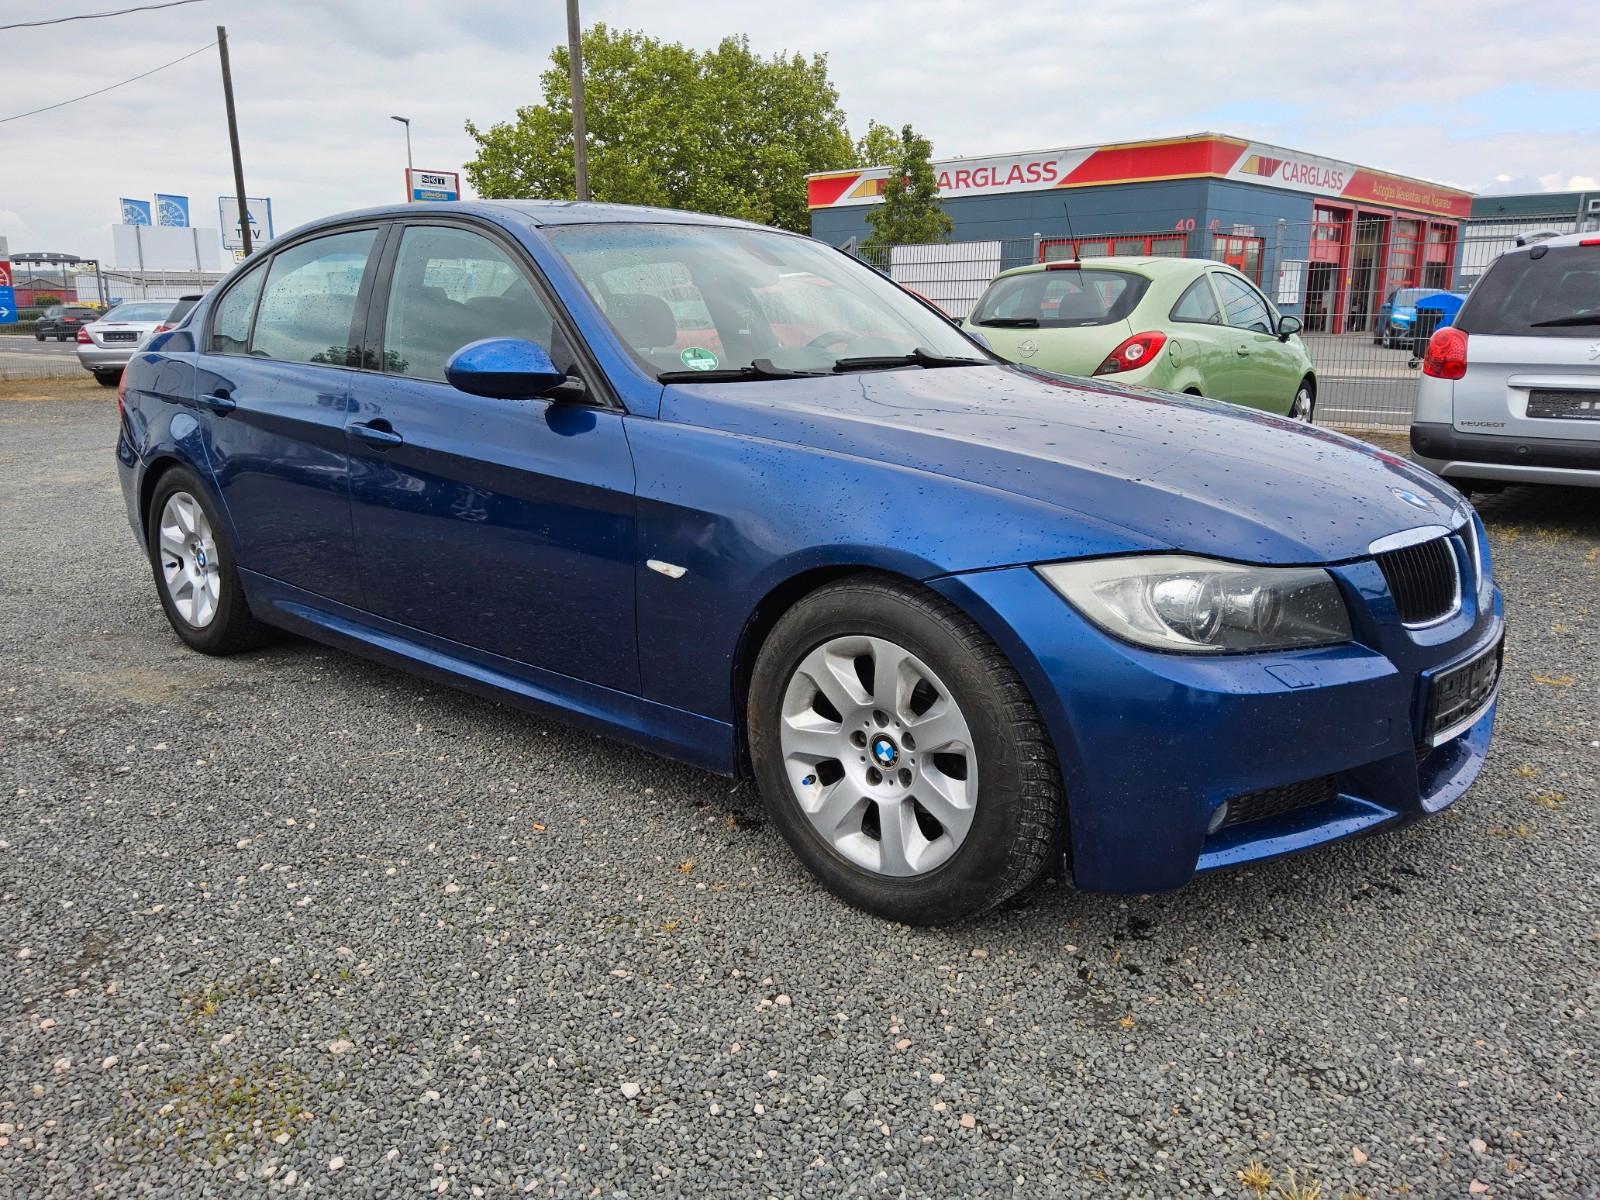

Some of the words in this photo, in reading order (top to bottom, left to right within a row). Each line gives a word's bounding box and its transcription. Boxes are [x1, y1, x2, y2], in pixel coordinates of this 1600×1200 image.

[936, 161, 1058, 190] ARGLASS
[1282, 160, 1344, 190] CARGLASS
[1175, 219, 1196, 231] 40
[235, 228, 261, 239] TV
[1460, 420, 1506, 428] PEUGEOT
